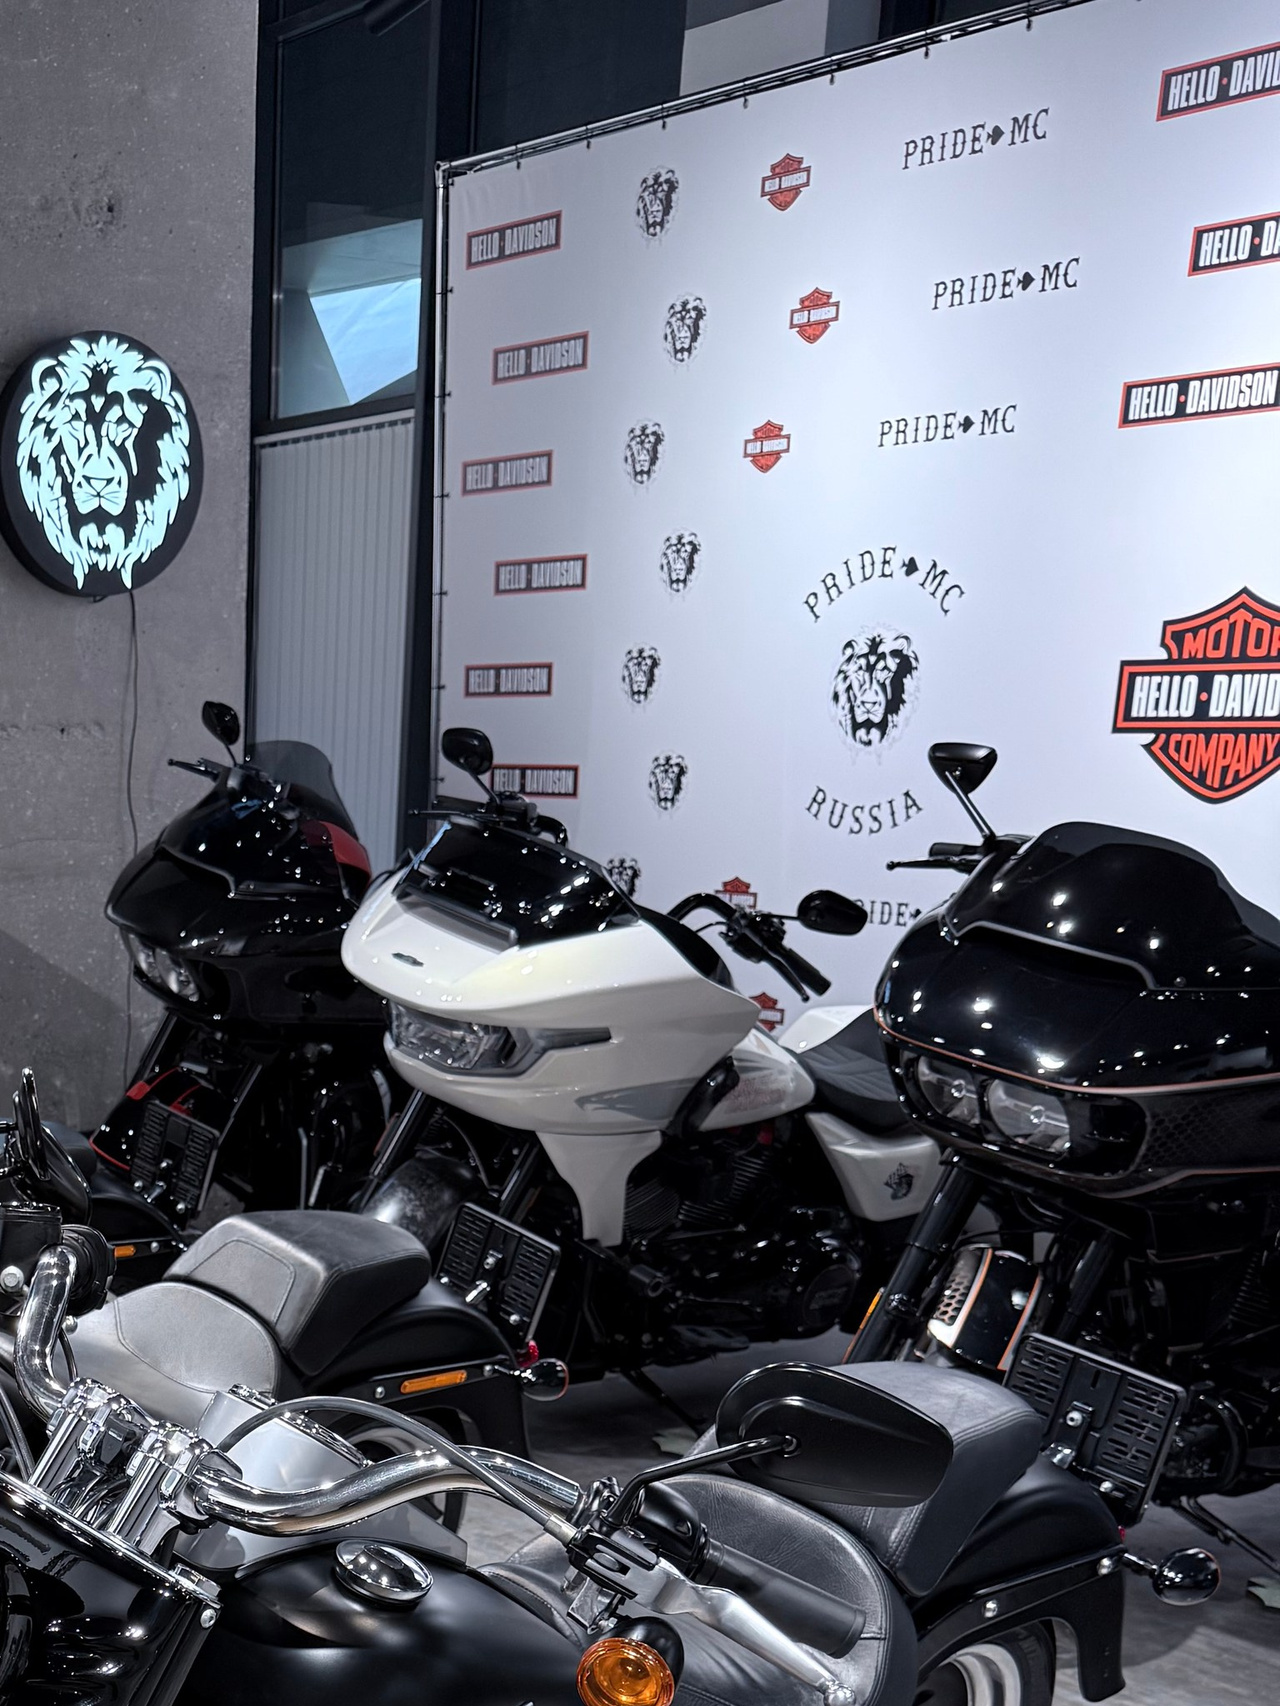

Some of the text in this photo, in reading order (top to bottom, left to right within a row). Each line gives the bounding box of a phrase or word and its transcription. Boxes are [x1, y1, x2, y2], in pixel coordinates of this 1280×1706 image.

[1167, 65, 1221, 111] HELLO
[902, 106, 1050, 170] PRIDE MC
[1198, 224, 1253, 267] HELLO
[931, 256, 1081, 310] PRIDE MC
[1128, 369, 1280, 421] HELLO DAVIDSON
[877, 404, 1018, 448] PRIDE MC
[803, 545, 966, 623] PRIDE MC
[1130, 675, 1199, 718] HELLO
[1167, 733, 1280, 789] COMPANY
[805, 785, 923, 836] RUSSIA
